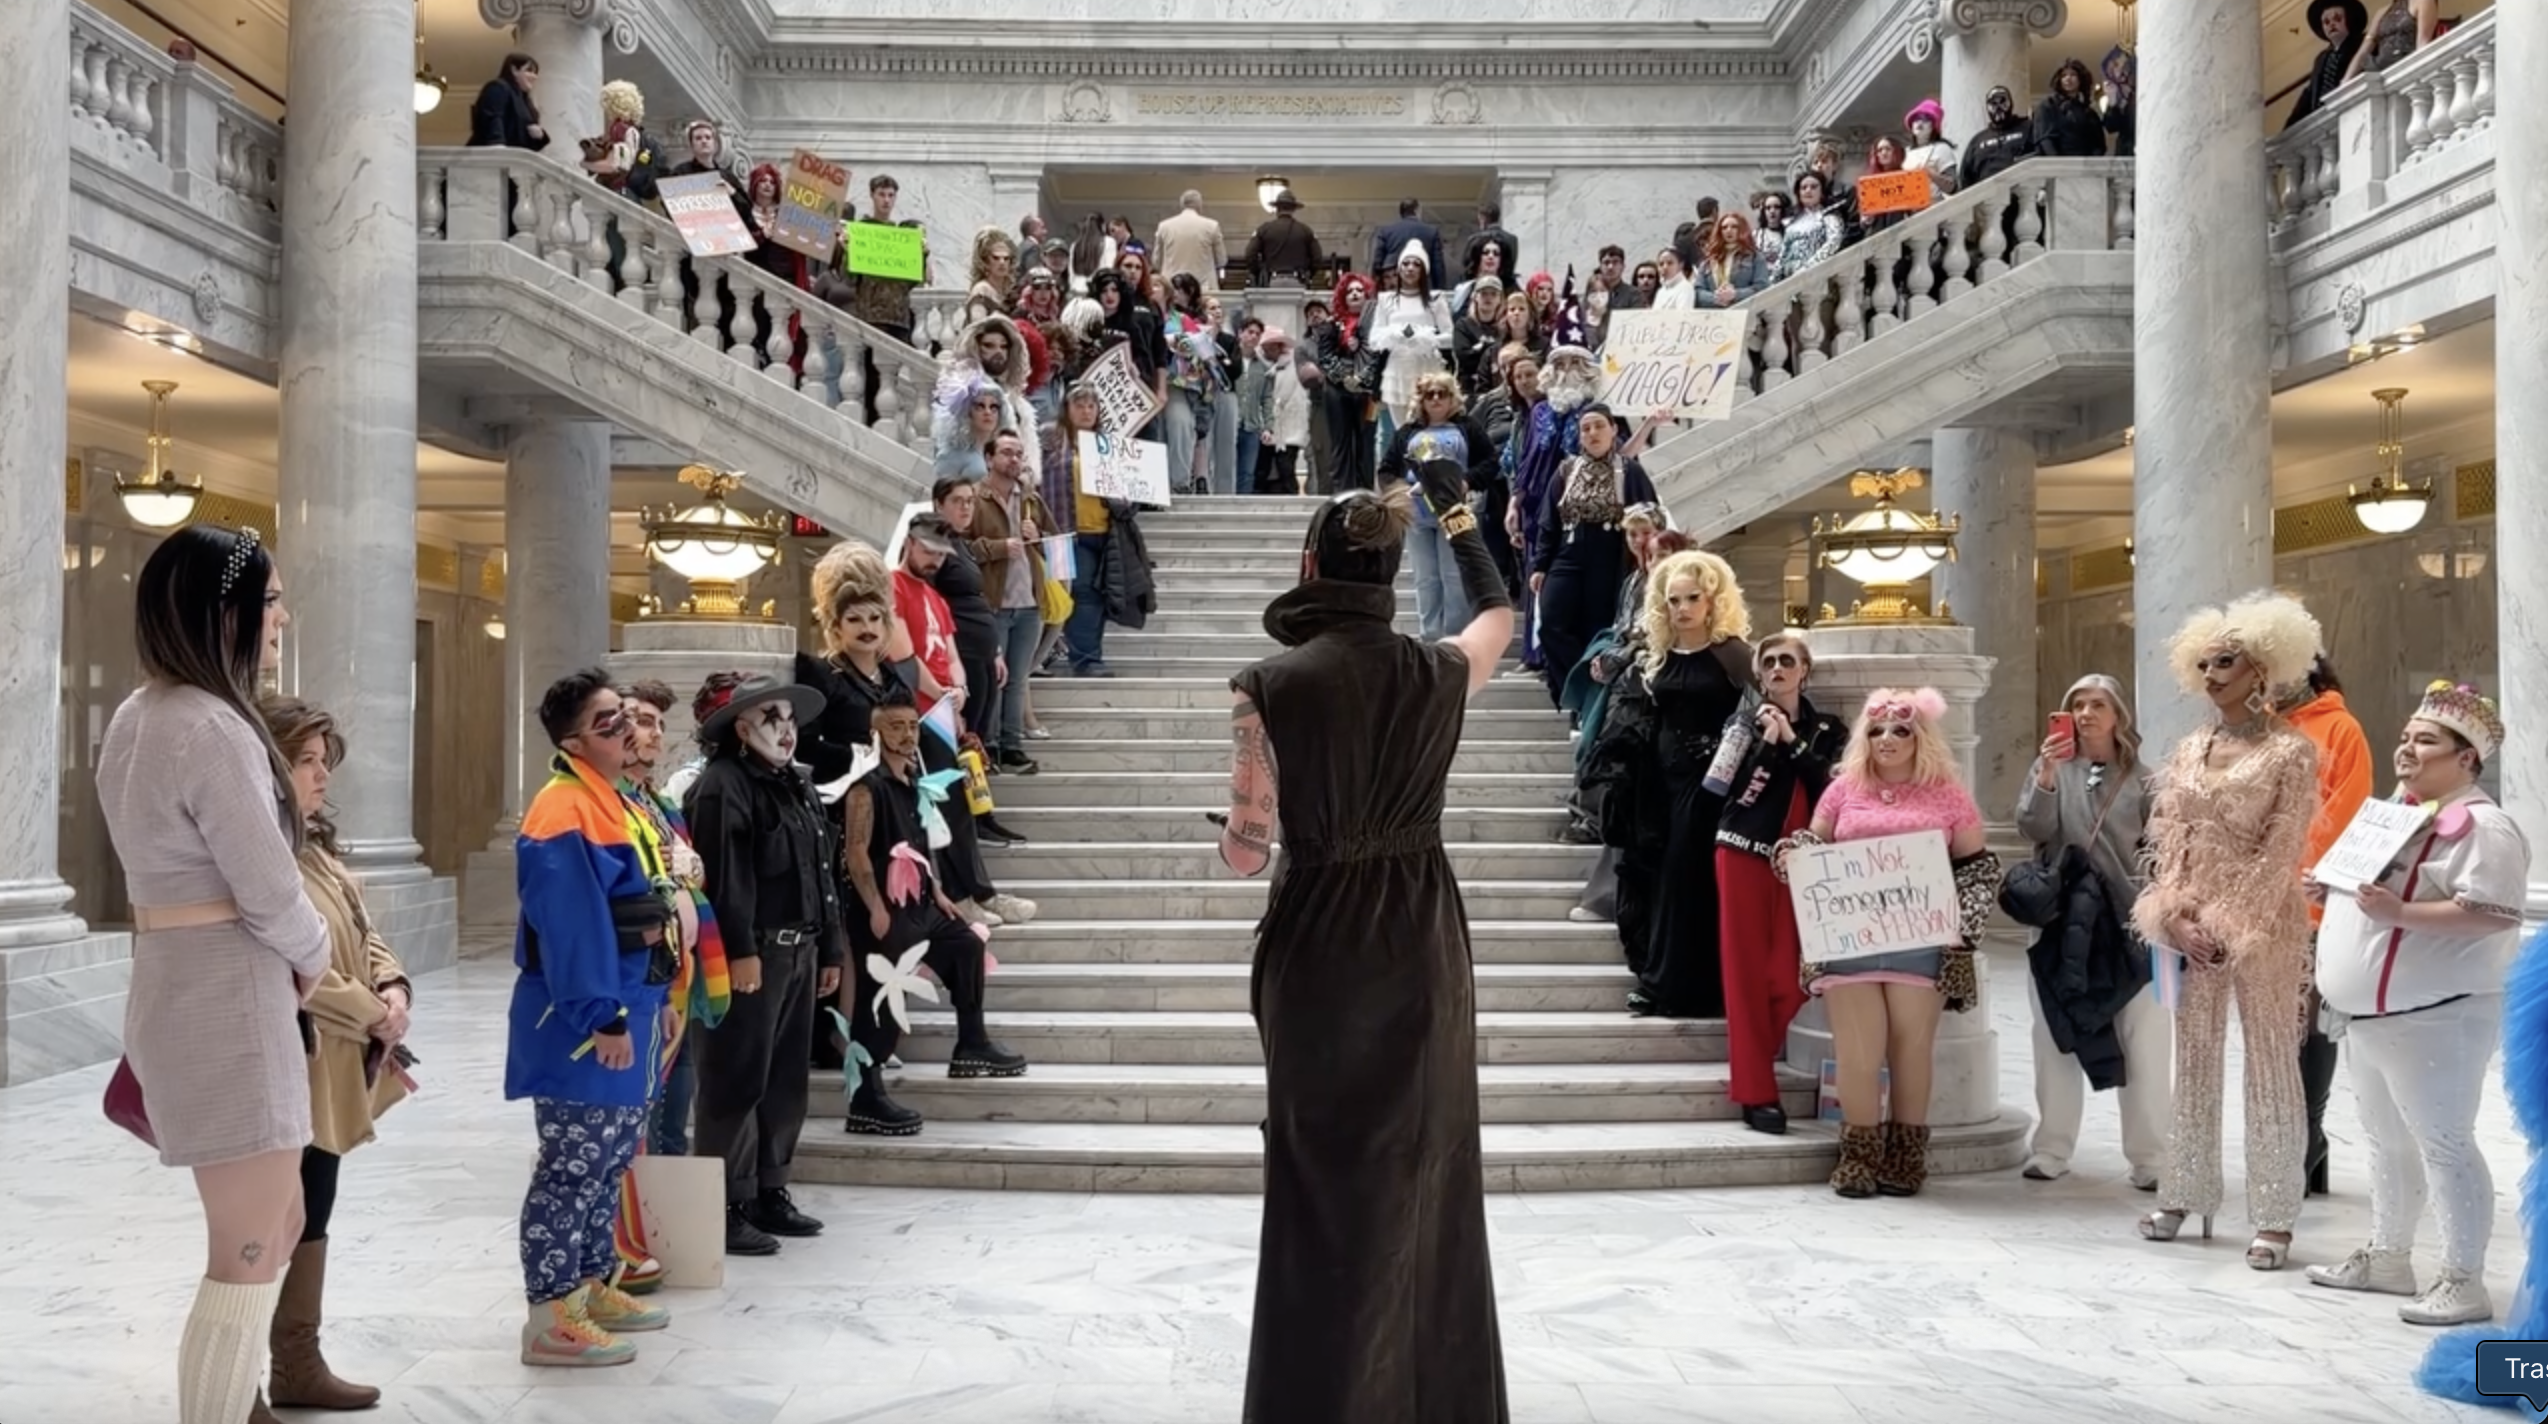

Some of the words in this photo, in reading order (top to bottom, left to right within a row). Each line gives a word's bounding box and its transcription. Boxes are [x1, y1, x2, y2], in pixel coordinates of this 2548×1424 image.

[1137, 93, 1197, 114] HOUSE
[1199, 94, 1225, 114] OF
[799, 154, 847, 187] DRAG
[787, 184, 824, 209] NOT
[823, 201, 838, 217] A
[1880, 185, 1904, 199] NOT
[1616, 322, 1671, 346] PUBLIC
[1676, 320, 1727, 345] DRAG
[1601, 361, 1733, 408] MAGIC!
[1095, 431, 1144, 460] DRAG
[1810, 848, 1865, 883] I'm
[1865, 840, 1910, 879] Not
[1803, 875, 1930, 922] Pornography
[1814, 921, 1858, 955] I'm
